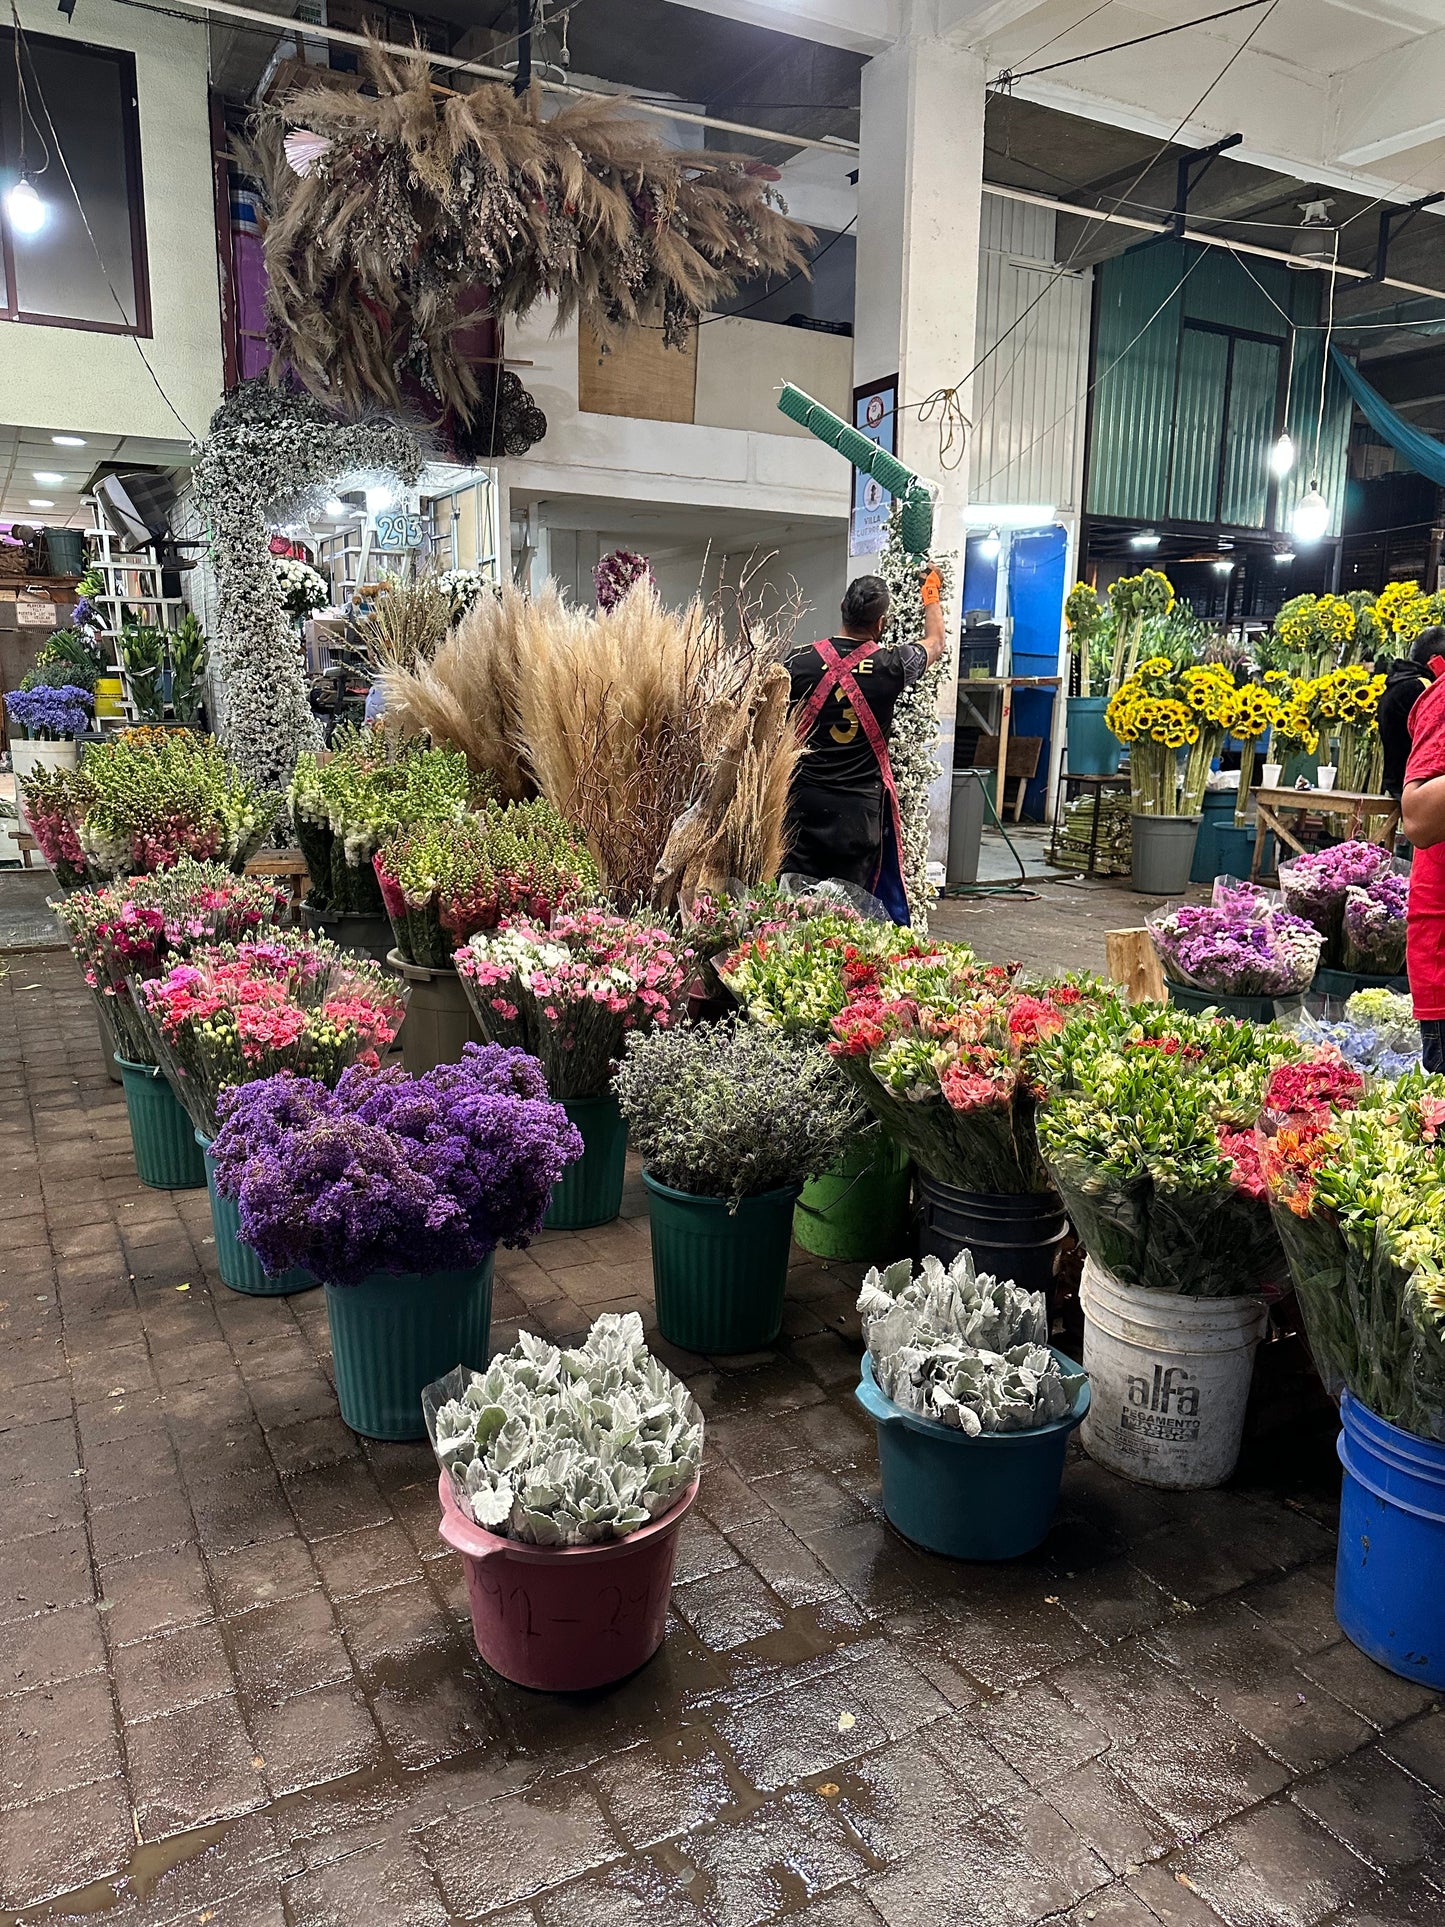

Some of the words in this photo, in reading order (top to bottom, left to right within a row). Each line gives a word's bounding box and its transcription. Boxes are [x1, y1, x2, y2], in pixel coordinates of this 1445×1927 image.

[378, 513, 423, 547] 295
[1128, 1364, 1200, 1416] alfa
[1123, 1406, 1201, 1428] PEGAMENTO
[1127, 1418, 1193, 1436] MADERA
